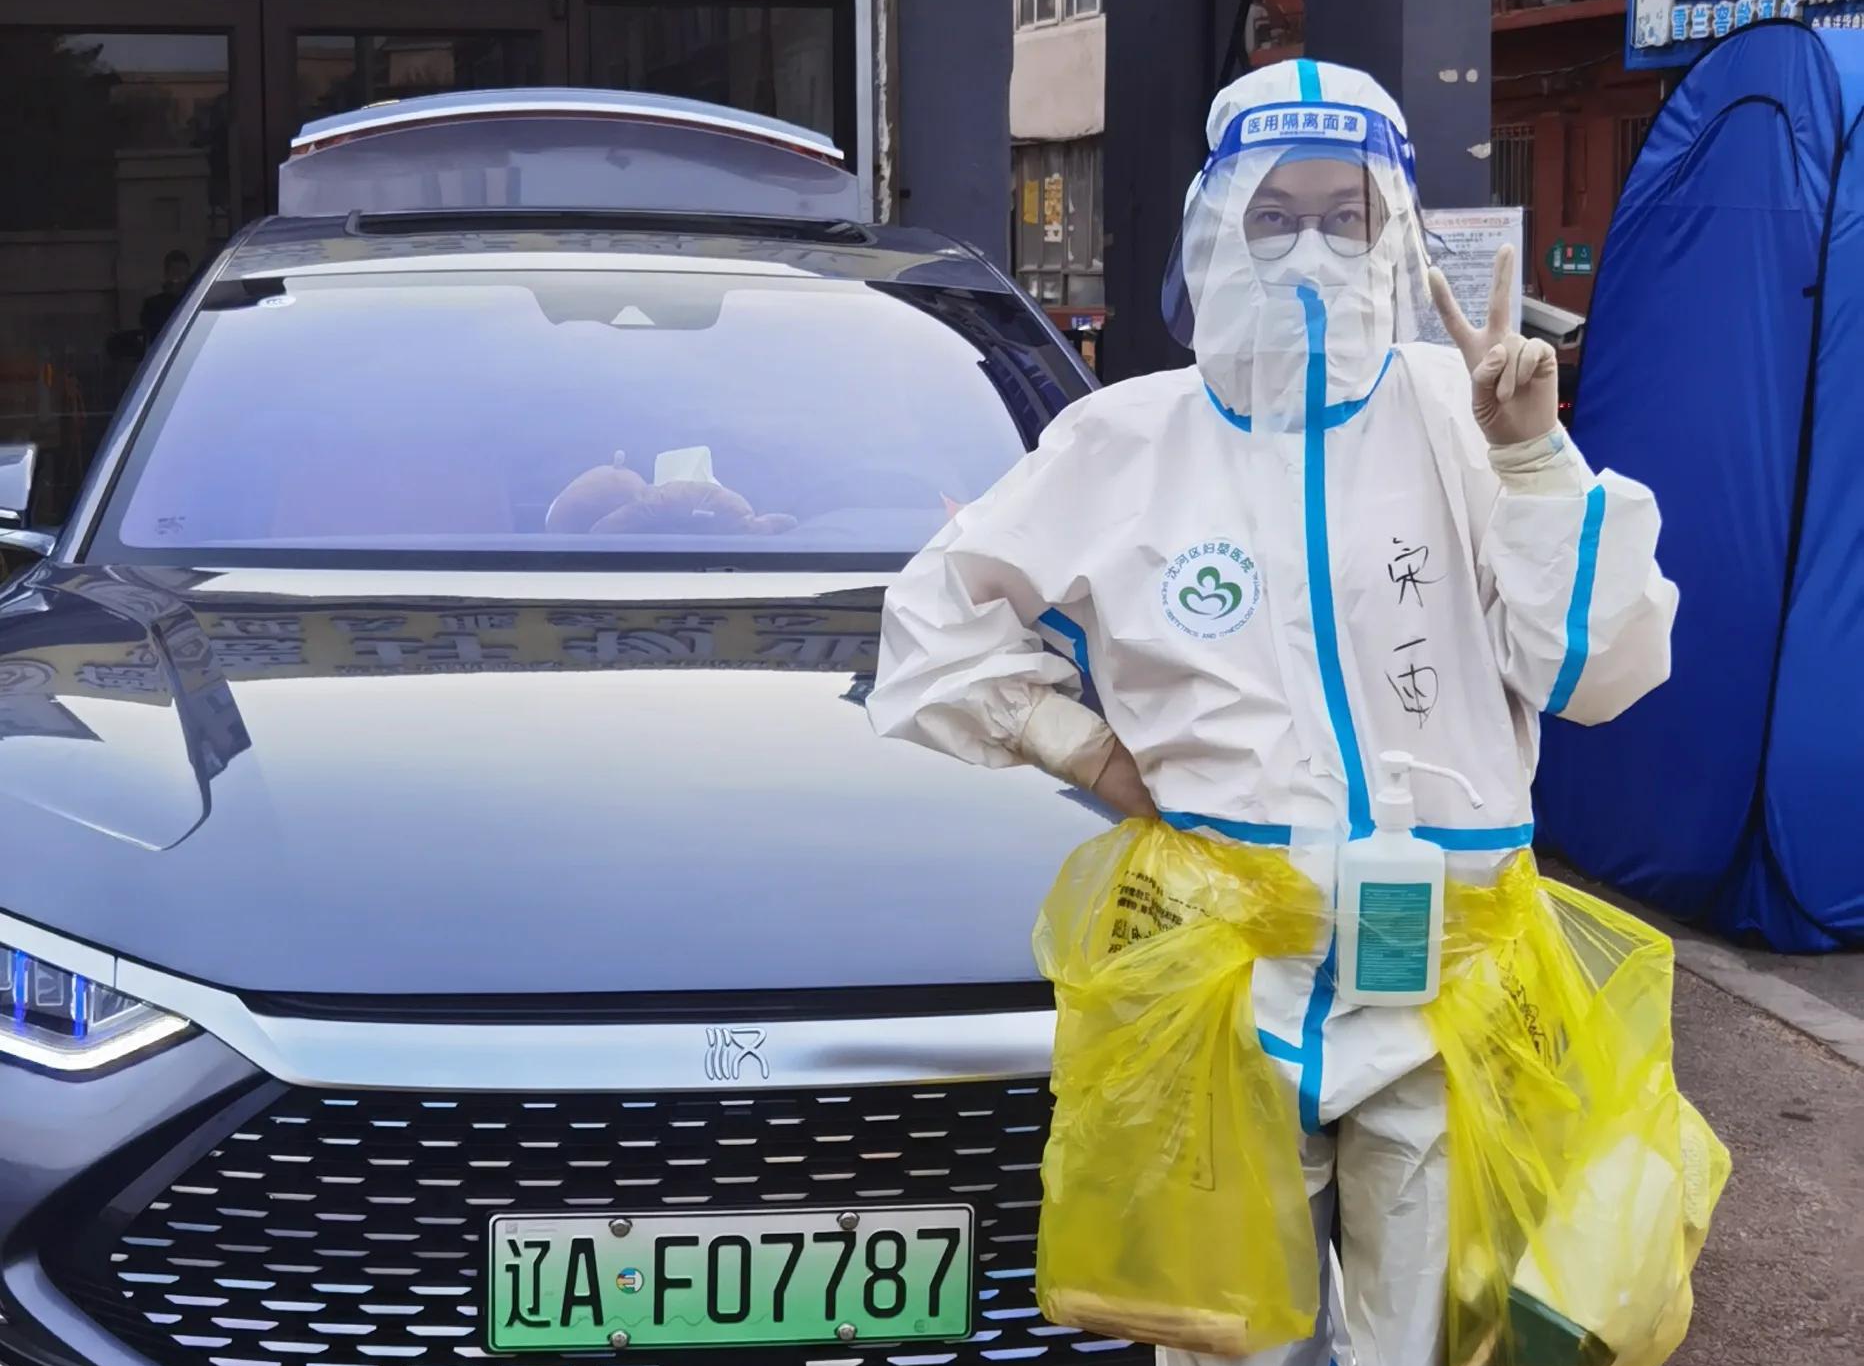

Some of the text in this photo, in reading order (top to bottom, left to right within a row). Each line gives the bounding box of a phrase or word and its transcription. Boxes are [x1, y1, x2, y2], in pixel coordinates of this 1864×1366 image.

[1247, 112, 1359, 135] 医用隔离面罩
[1164, 542, 1255, 580] 沈河区妇婴医院
[504, 1227, 961, 1330] 辽A F07787
